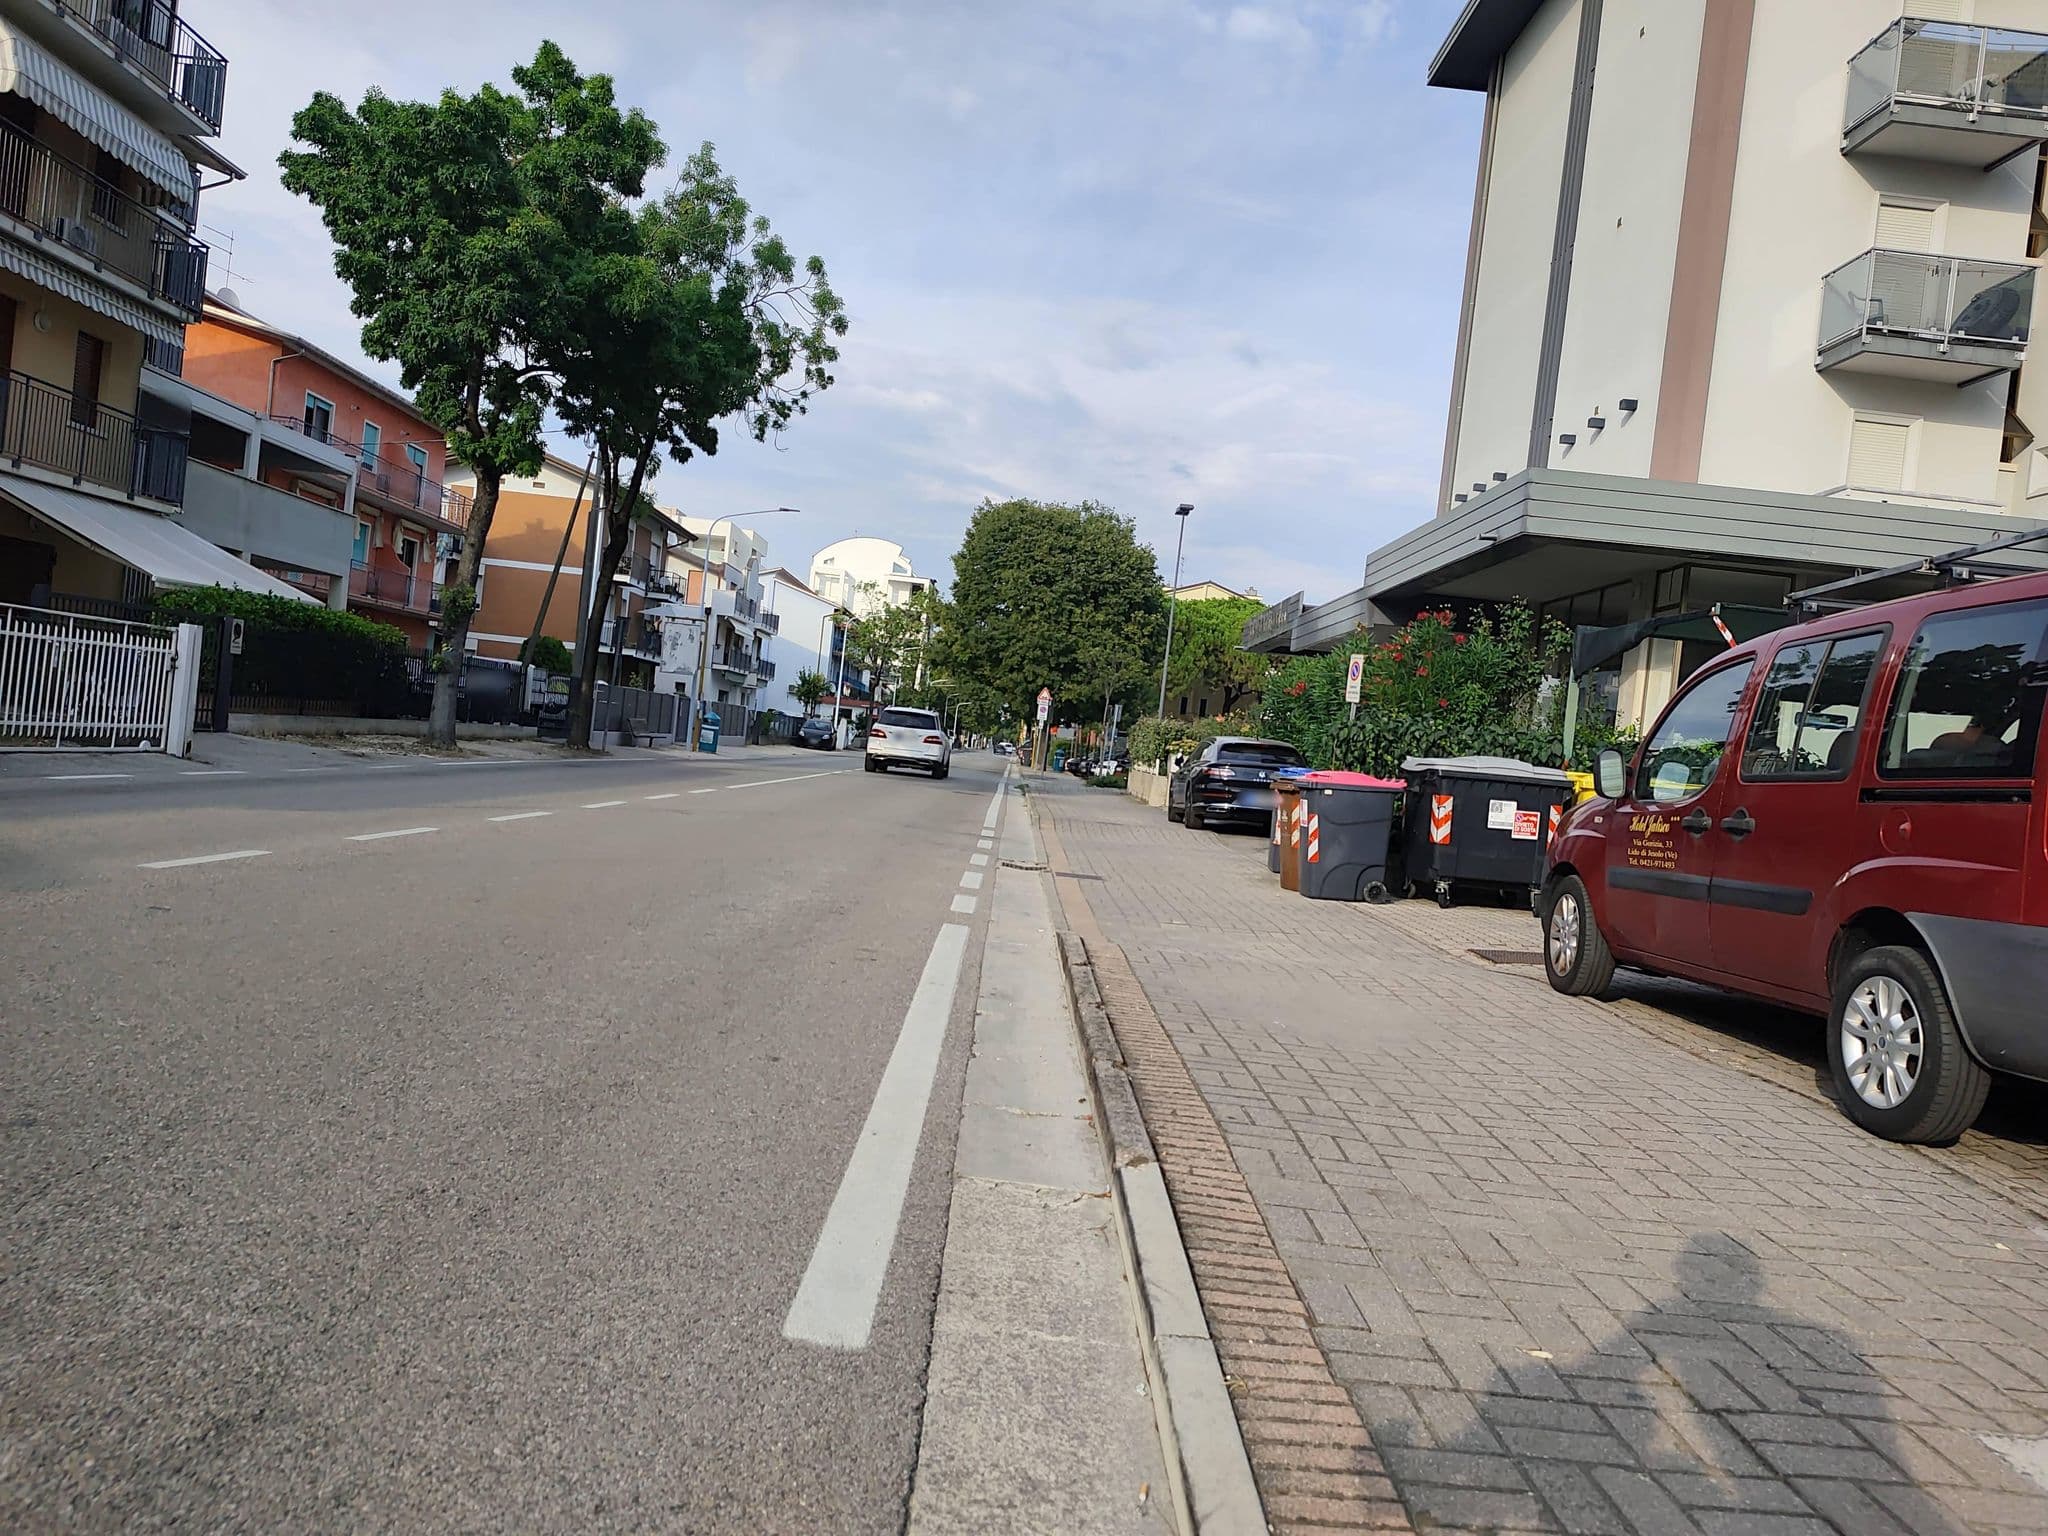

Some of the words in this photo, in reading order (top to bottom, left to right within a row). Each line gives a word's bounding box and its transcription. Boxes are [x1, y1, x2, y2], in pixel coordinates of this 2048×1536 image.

[1629, 814, 1650, 831] Hotel
[1628, 848, 1640, 856] Lido
[1648, 849, 1664, 858] Jesolo
